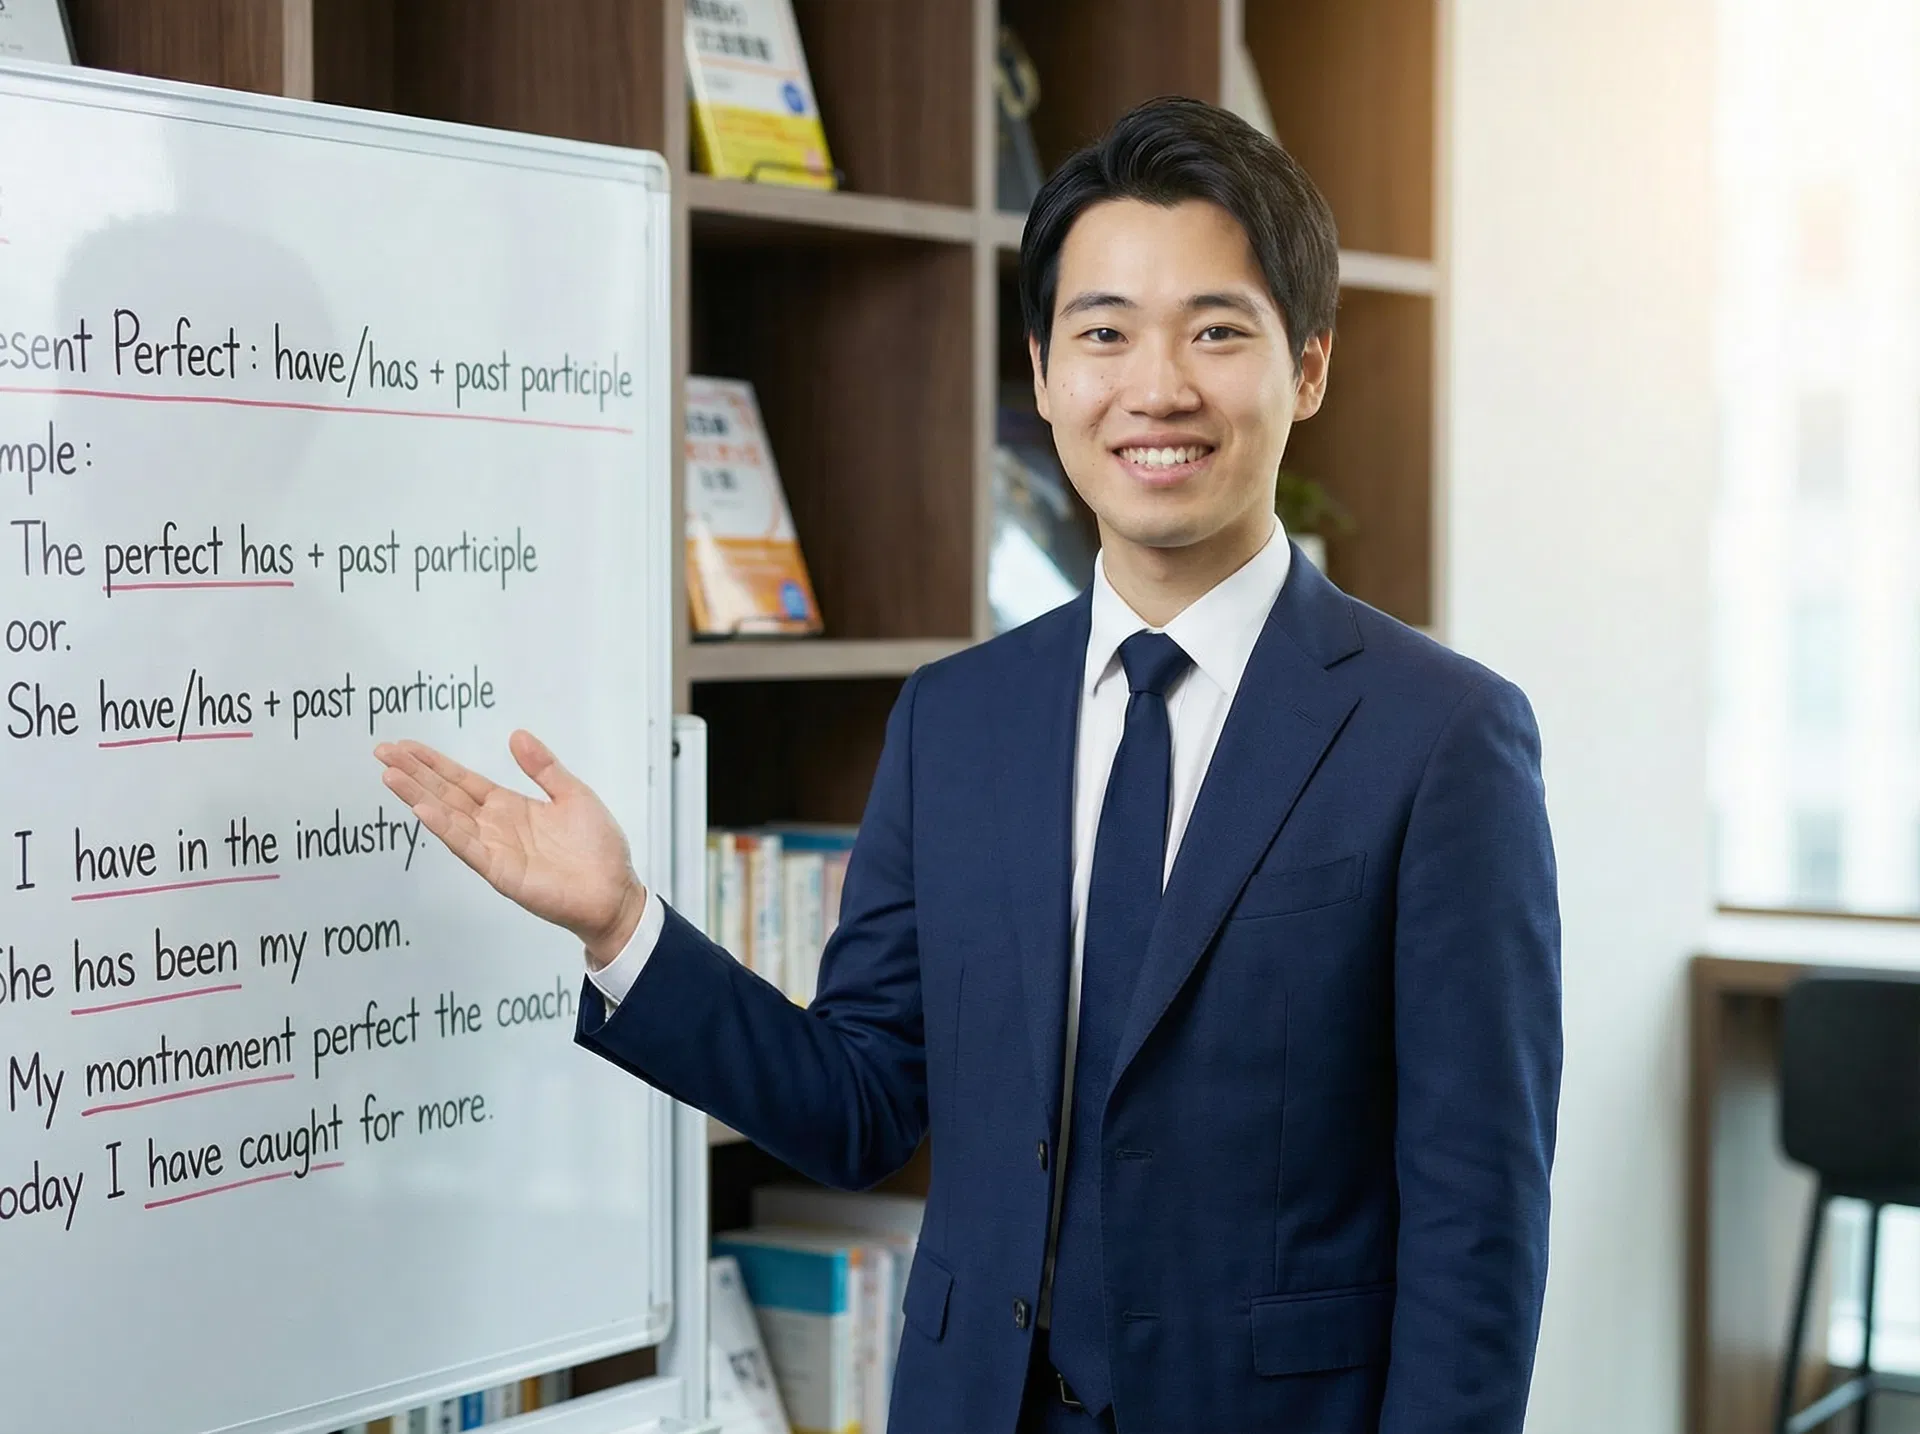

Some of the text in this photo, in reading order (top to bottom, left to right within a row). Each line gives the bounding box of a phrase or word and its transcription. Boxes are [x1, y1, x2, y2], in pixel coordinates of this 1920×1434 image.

[275, 322, 418, 398] have/has
[430, 360, 444, 384] +
[456, 350, 510, 408] past
[522, 351, 632, 412] participle
[10, 520, 537, 598] The perfect has + past participle
[6, 620, 71, 653] oor.
[7, 665, 495, 742] She have/has + past participle
[14, 805, 427, 890] I have in the industry.
[72, 938, 135, 993] has
[153, 927, 237, 981] been
[260, 931, 307, 984] my
[324, 919, 410, 957] room.
[10, 974, 577, 1130] My montnament perfect the coach.
[105, 1141, 125, 1199] I
[149, 1137, 224, 1188] have
[238, 1104, 344, 1178] caught
[359, 1093, 404, 1145] for
[418, 1095, 493, 1134] more.
